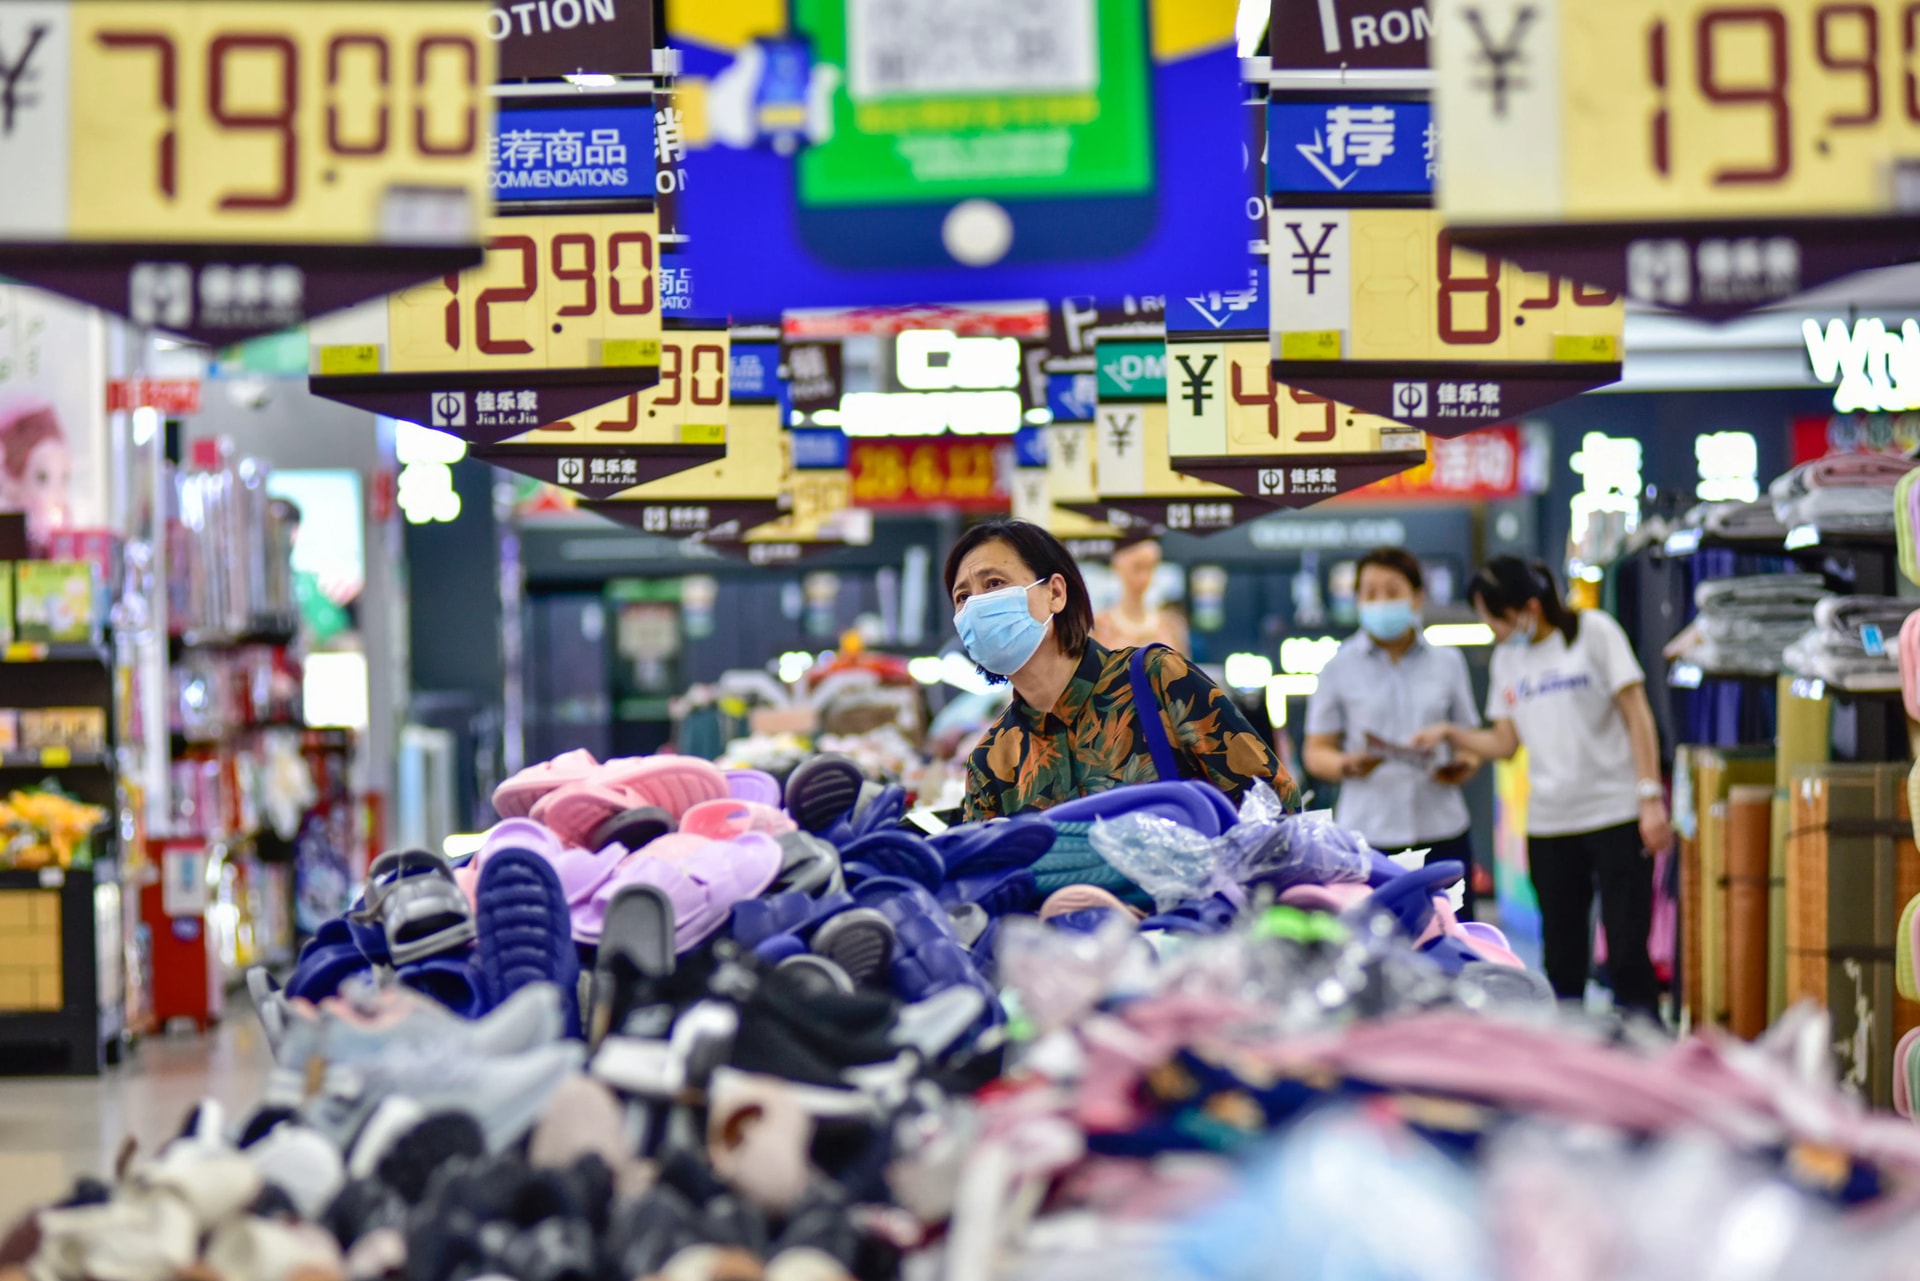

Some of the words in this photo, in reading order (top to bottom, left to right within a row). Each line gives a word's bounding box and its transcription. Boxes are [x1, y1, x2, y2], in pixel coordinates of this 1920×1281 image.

[92, 27, 480, 212] 79.00
[1285, 222, 1338, 295] ¥
[444, 231, 655, 356] 12.90
[475, 391, 538, 412] 佳乐家
[1175, 355, 1218, 416] ¥
[1436, 382, 1500, 403] 佳乐家
[475, 411, 497, 426] Jia
[498, 411, 516, 425] Le
[517, 411, 538, 425] Jia
[1436, 403, 1458, 418] Jia
[1460, 403, 1478, 417] Le
[1479, 403, 1500, 418] Jia
